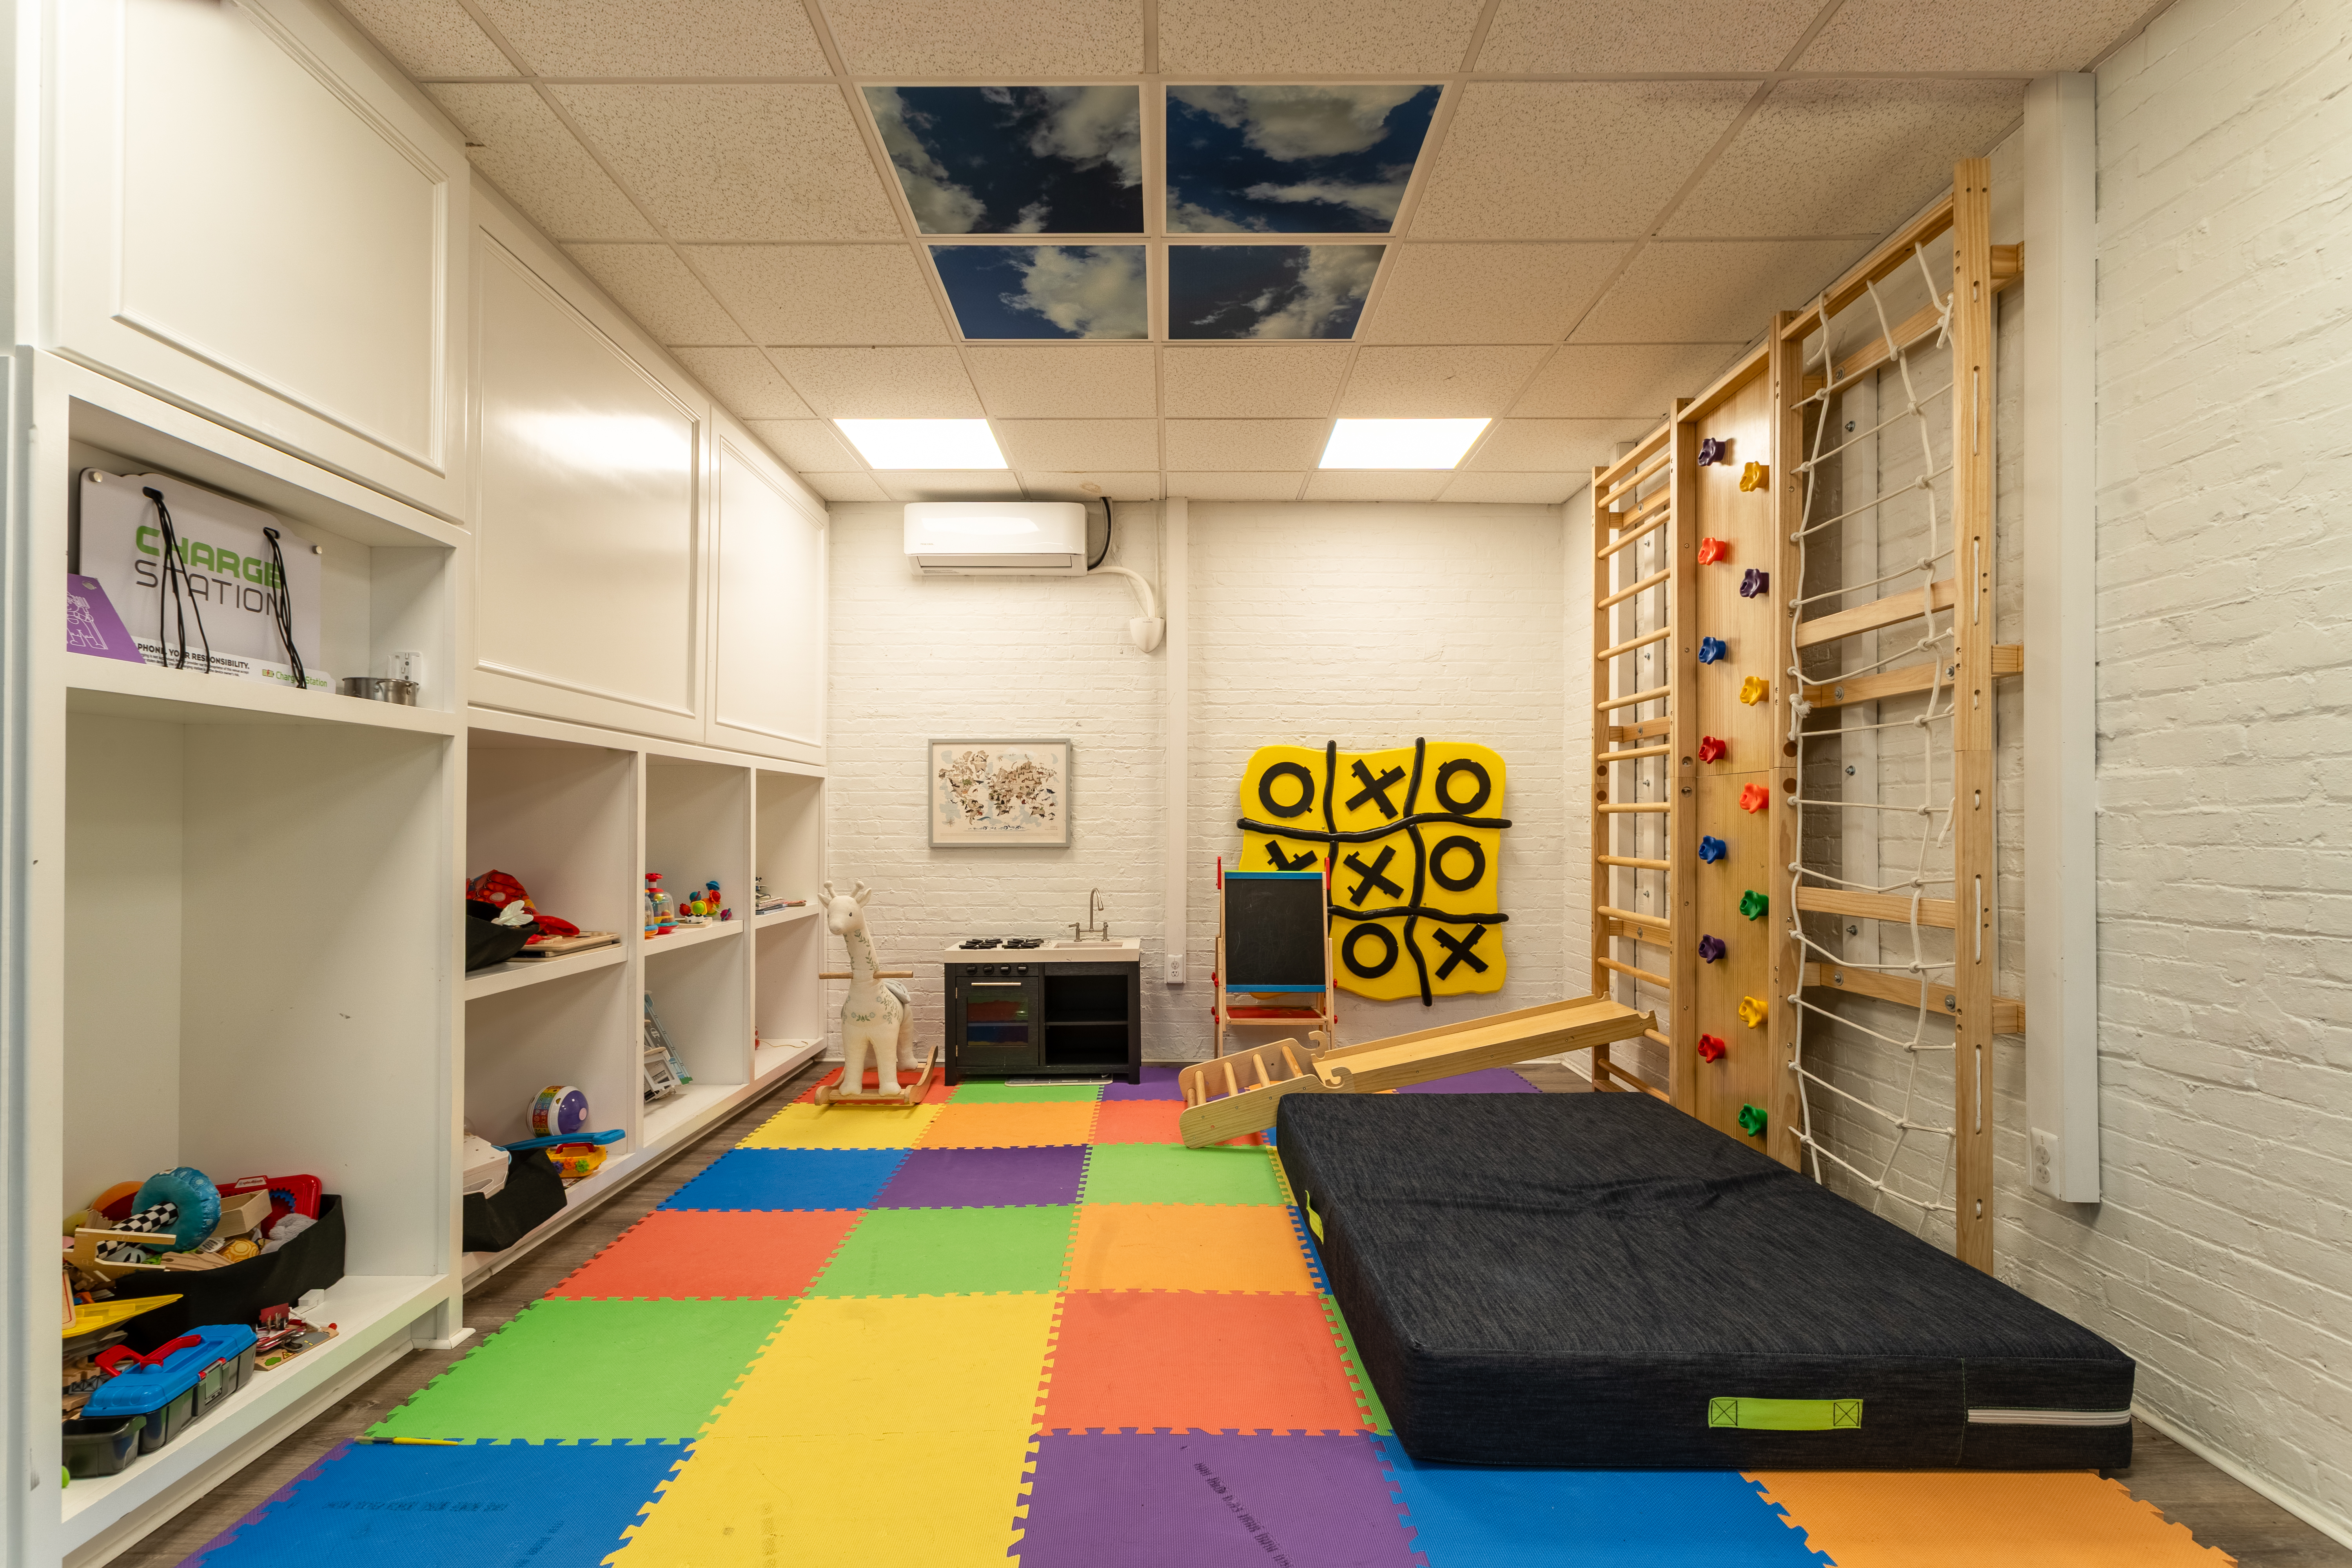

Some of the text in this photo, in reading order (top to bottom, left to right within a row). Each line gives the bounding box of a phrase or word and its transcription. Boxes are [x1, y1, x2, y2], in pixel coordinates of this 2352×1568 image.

[136, 526, 281, 589] CHARGE
[169, 649, 190, 659] YOR
[305, 676, 327, 687] Station
